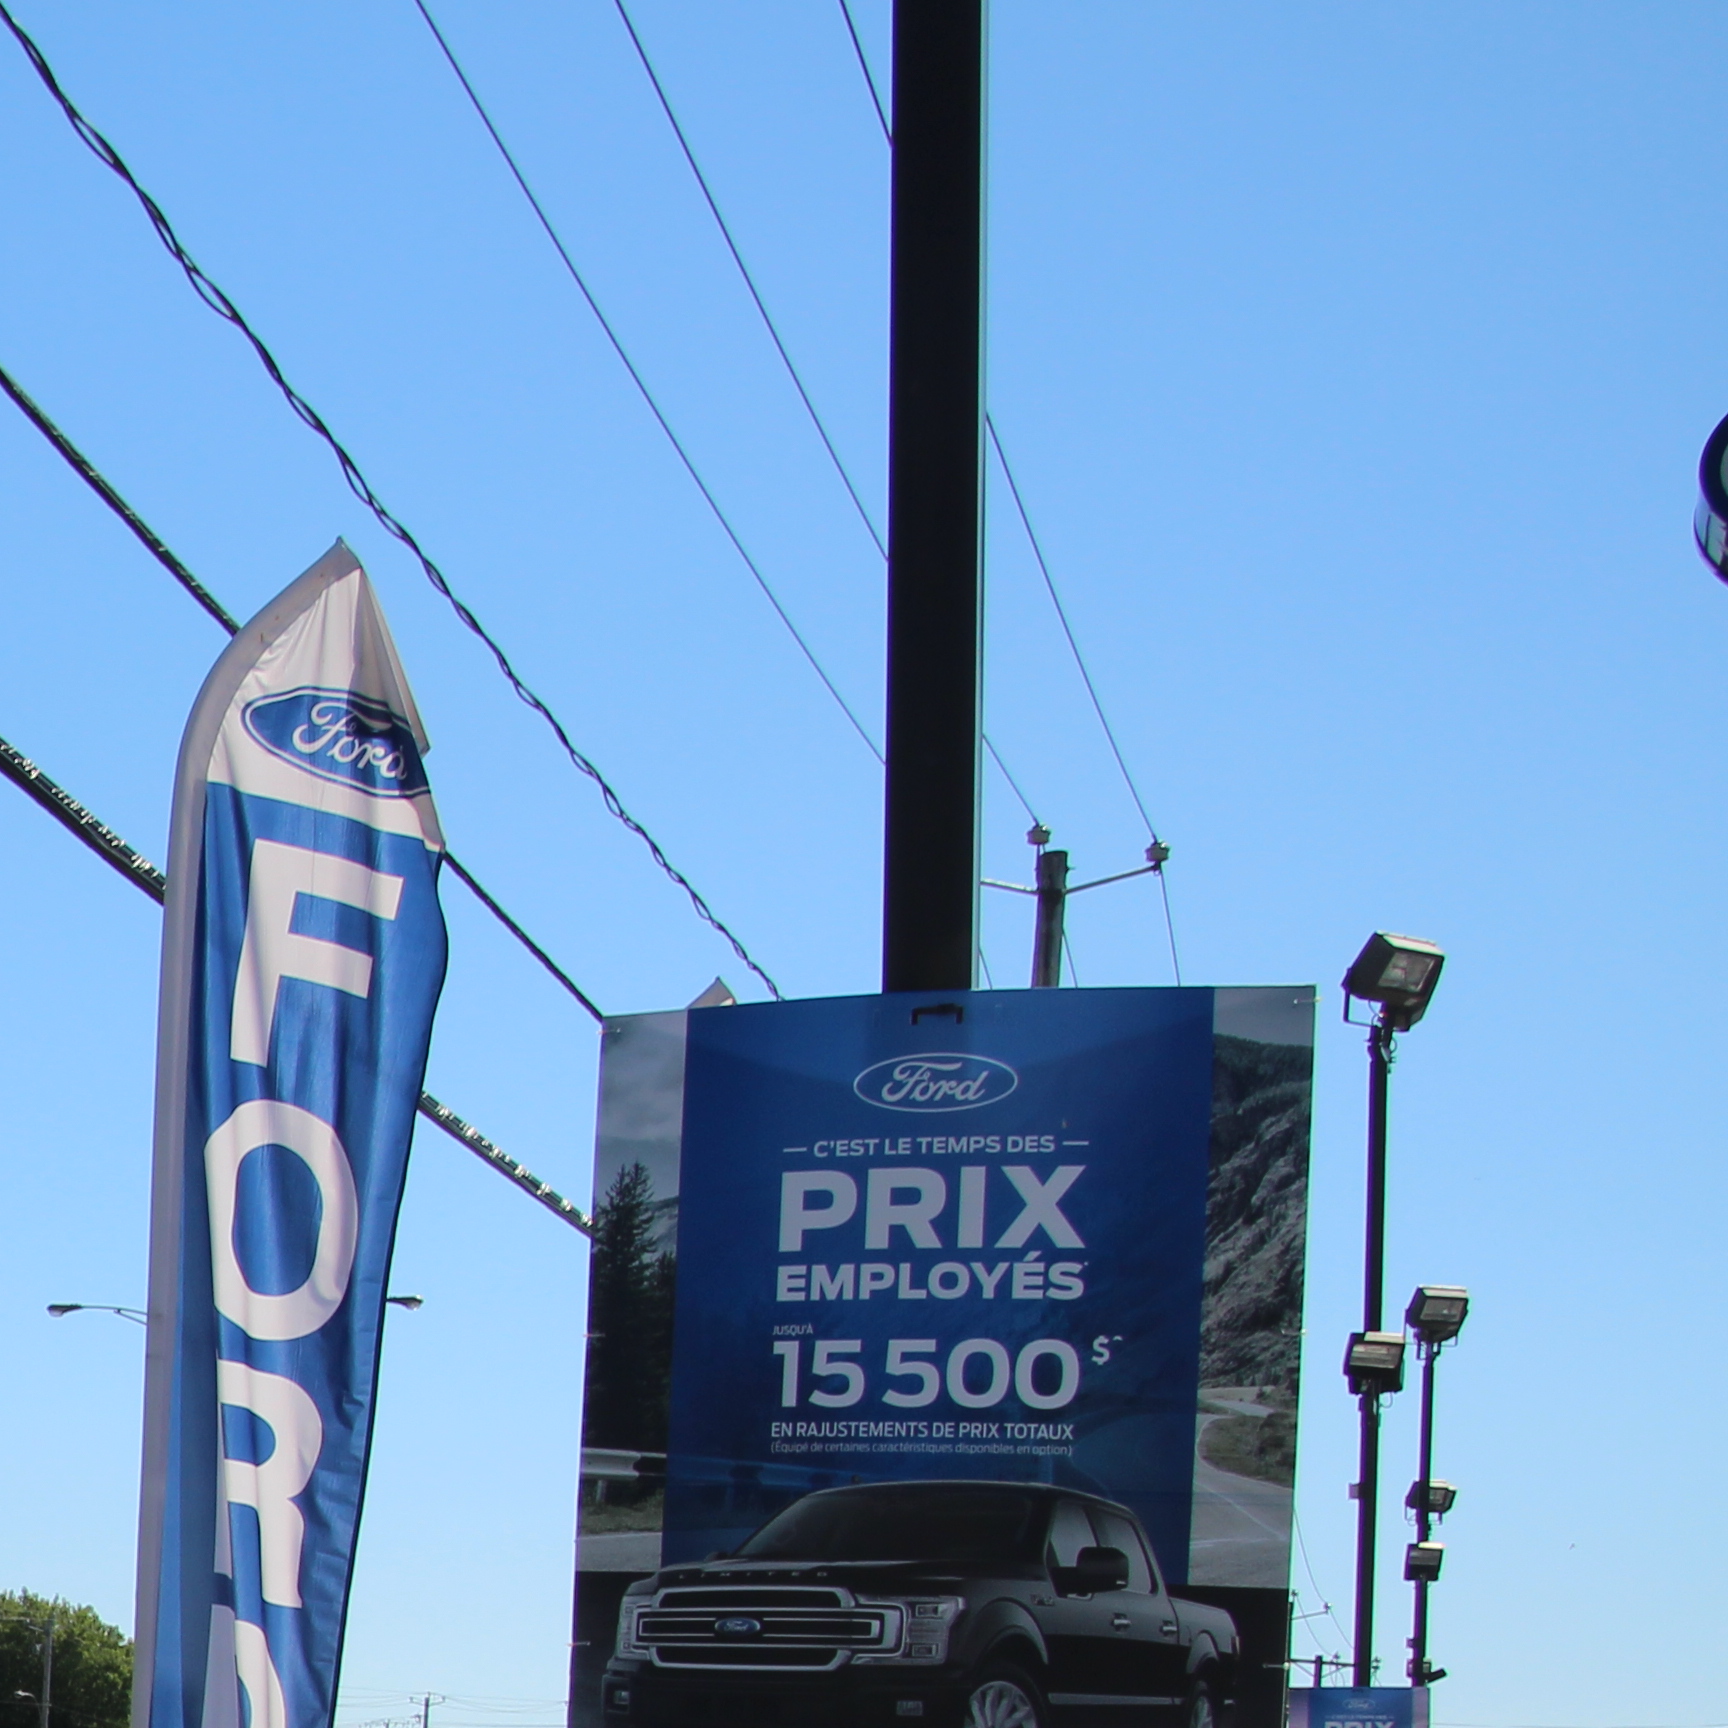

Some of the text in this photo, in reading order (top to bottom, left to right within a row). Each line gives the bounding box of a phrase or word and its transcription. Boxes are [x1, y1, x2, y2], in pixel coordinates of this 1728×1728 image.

[292, 701, 409, 780] Ford
[881, 1061, 990, 1102] Ford
[813, 1135, 1055, 1158] C'EST LE TEMPS DES
[778, 1165, 1087, 1252] PRIX
[772, 1324, 814, 1336] JUSQU'À
[771, 1422, 1075, 1441] EN RAJUSTEMENTS DE PRIX TOTAUX
[770, 1440, 1073, 1457] (Équipé de certaines caractéristiques disponibles en option)
